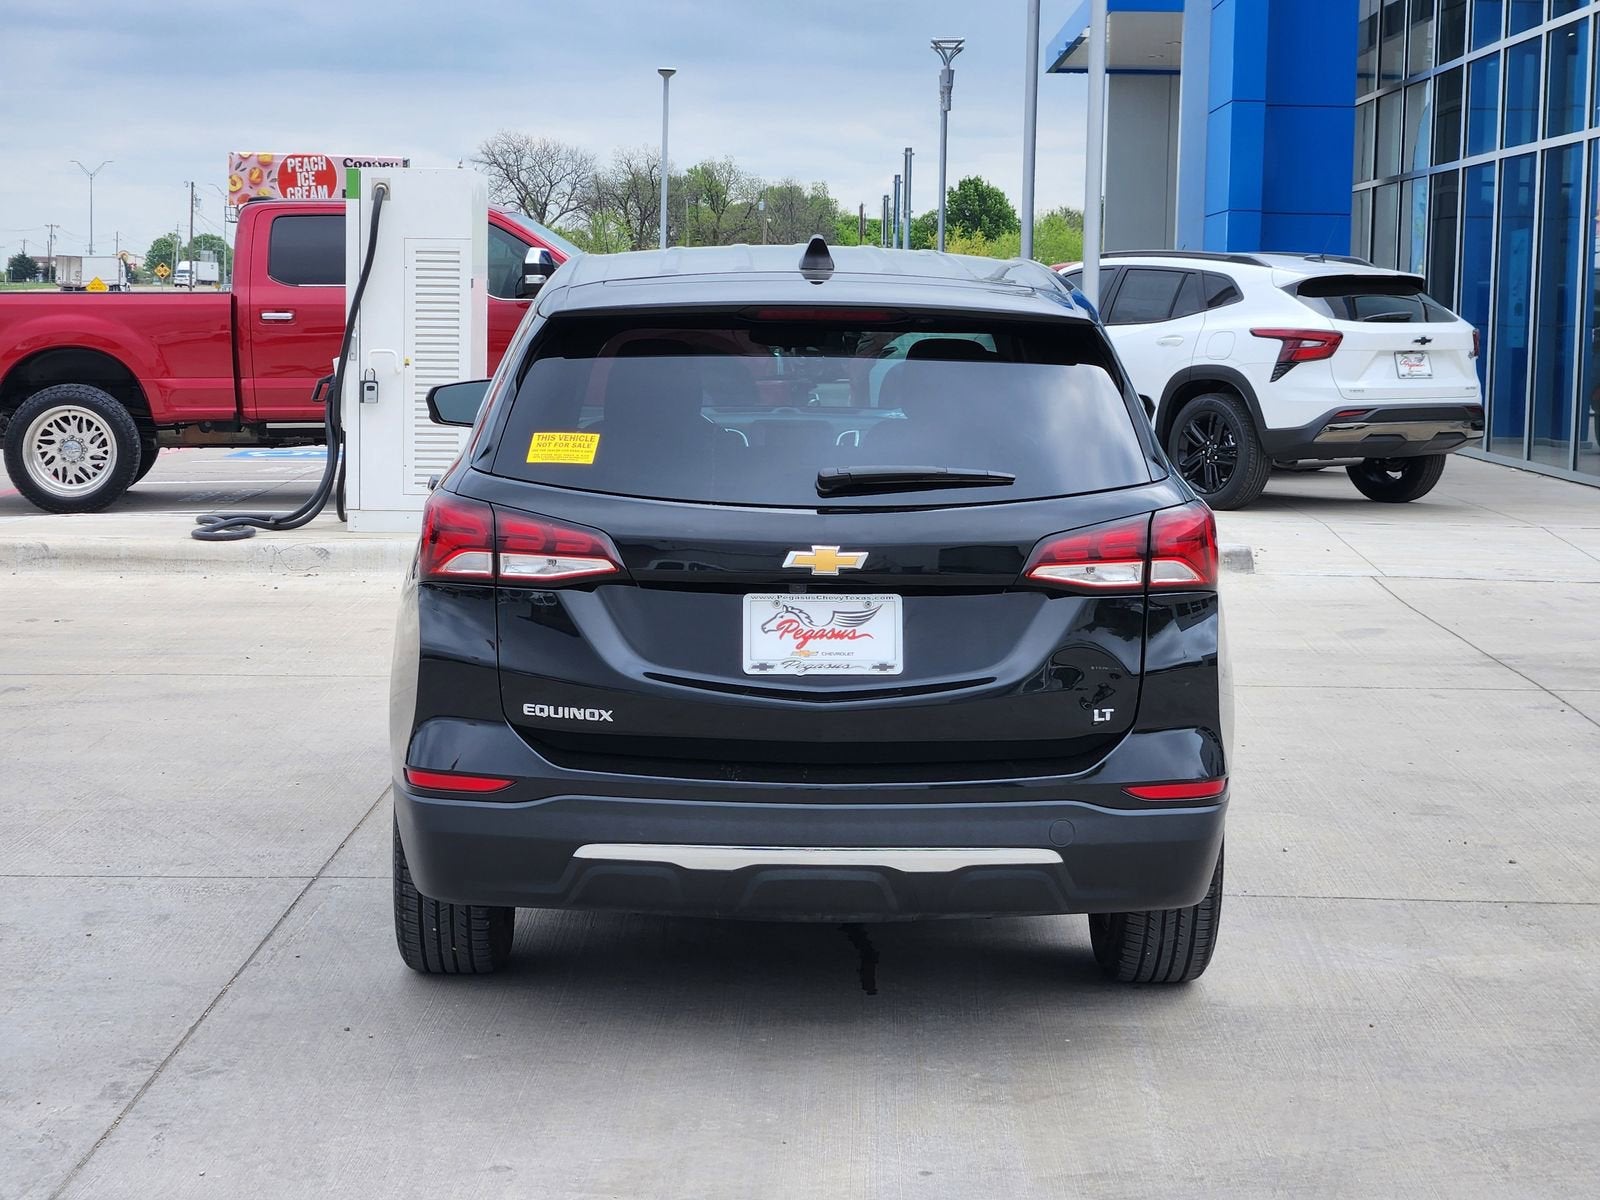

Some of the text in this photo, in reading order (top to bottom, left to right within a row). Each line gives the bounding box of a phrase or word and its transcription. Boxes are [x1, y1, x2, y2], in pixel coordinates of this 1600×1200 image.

[287, 156, 327, 172] PEACH
[296, 171, 316, 186] ICE
[286, 185, 328, 199] CREAM
[537, 434, 596, 443] THIS VEHICLE
[776, 618, 874, 650] Pegasus
[781, 660, 865, 673] Pegasus
[522, 703, 614, 722] EQUINOX
[1093, 708, 1115, 722] LT
